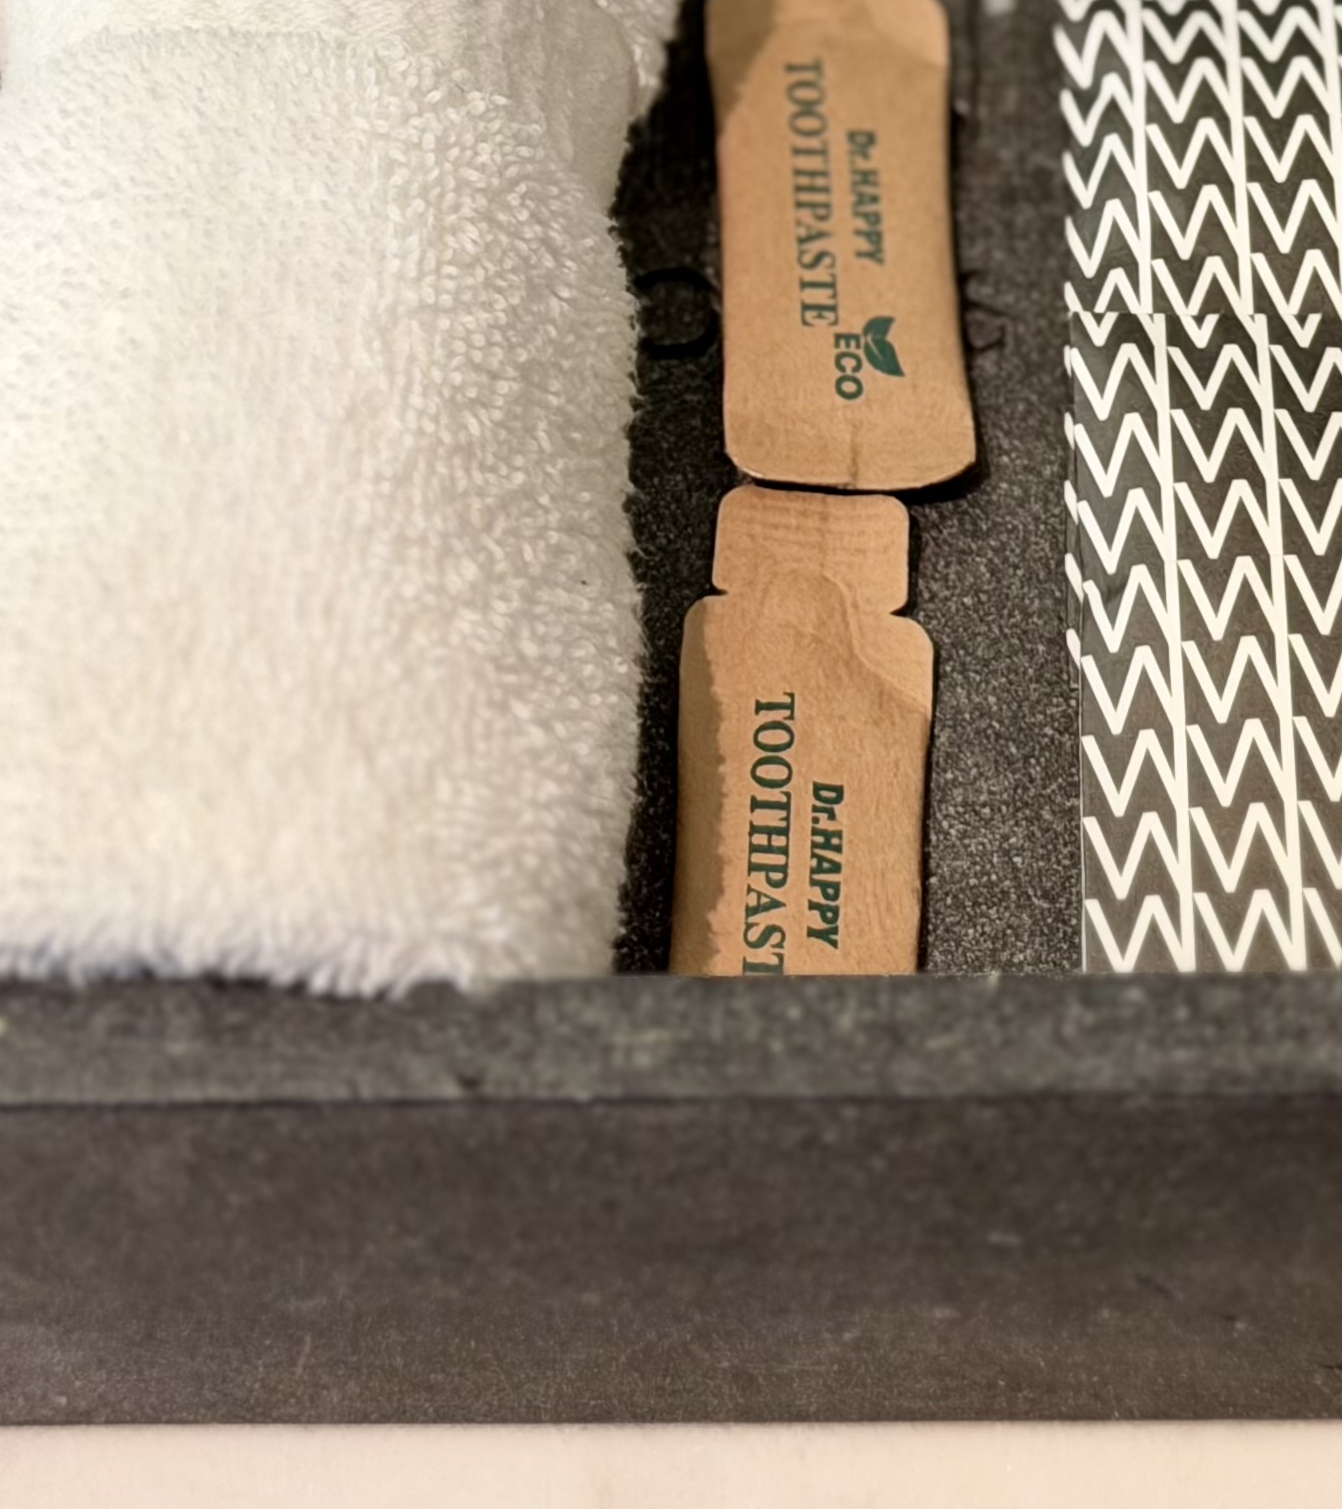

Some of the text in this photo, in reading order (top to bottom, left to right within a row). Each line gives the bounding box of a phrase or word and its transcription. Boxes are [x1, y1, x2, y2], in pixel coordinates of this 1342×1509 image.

[783, 57, 840, 328] TOOTHPASTE
[833, 331, 865, 401] ECO
[742, 691, 796, 976] TOOTHPAST
